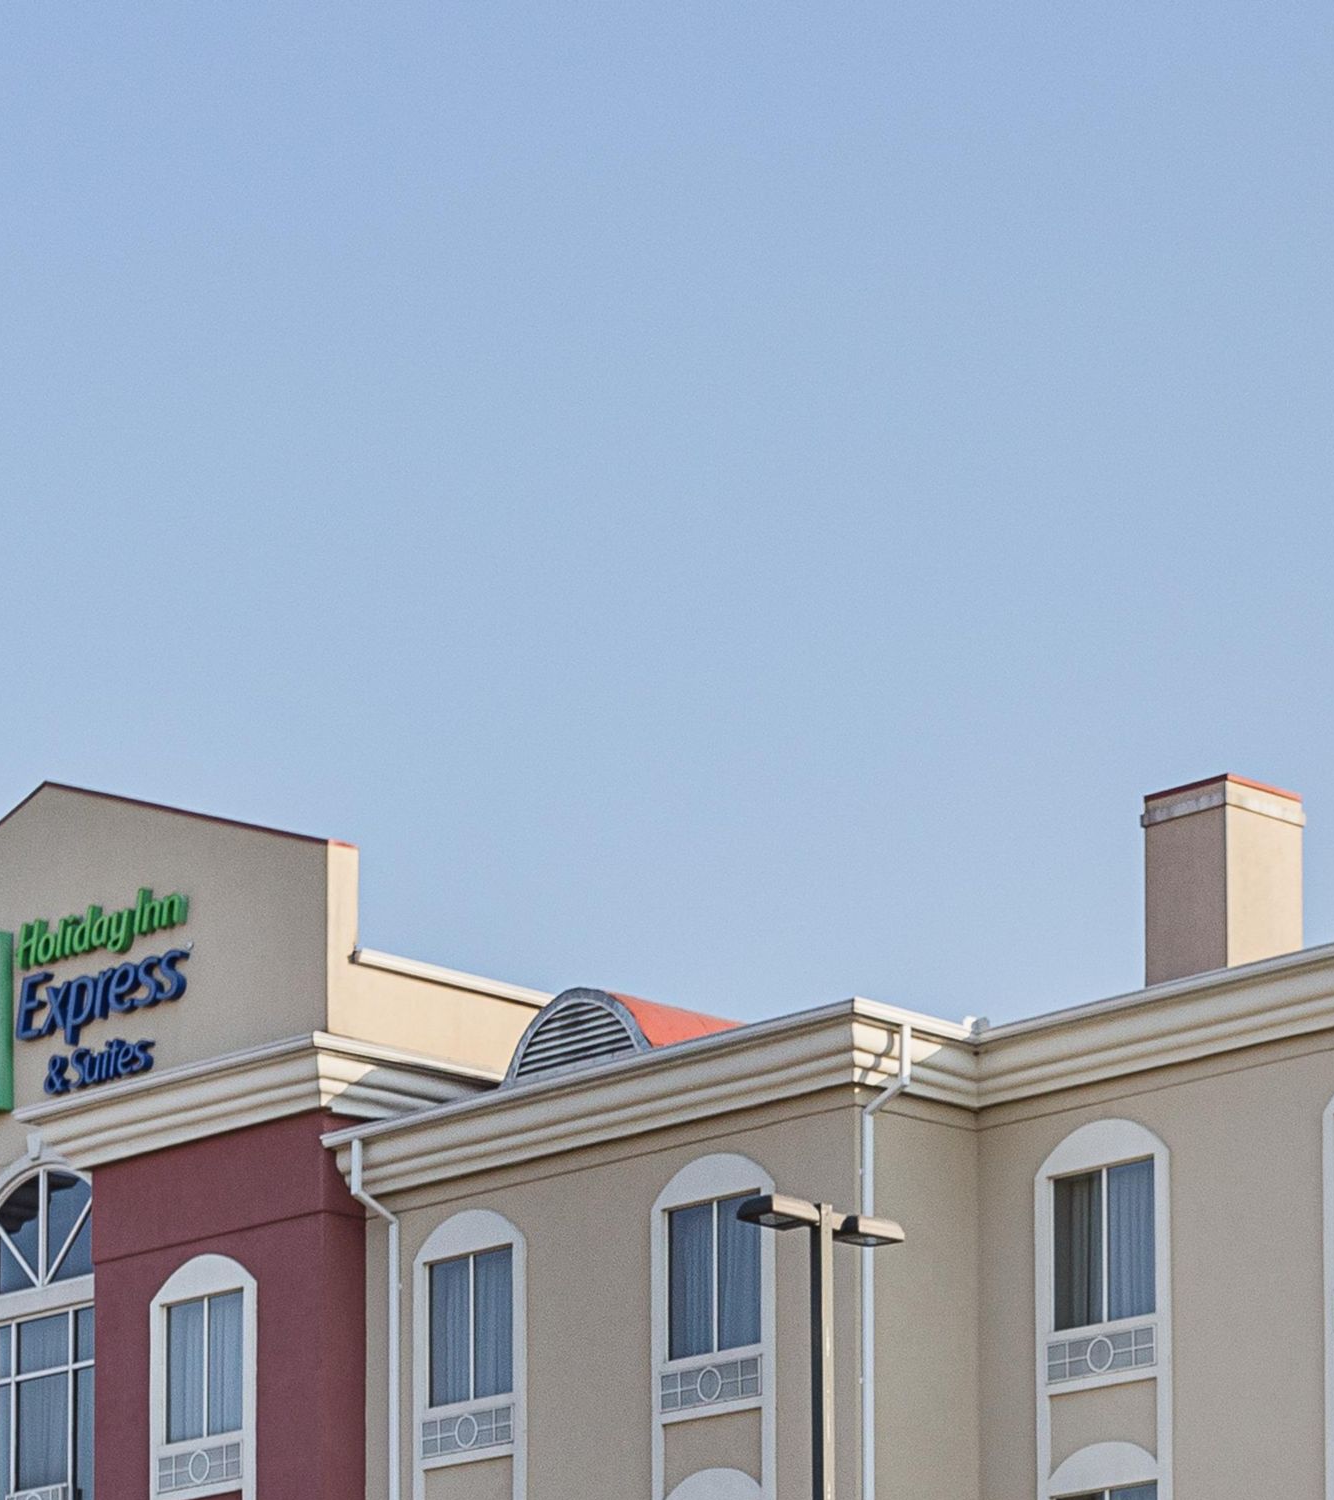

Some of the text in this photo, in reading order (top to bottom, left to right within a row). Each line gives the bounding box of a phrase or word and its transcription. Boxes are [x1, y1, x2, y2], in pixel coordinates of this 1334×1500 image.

[17, 888, 189, 970] Holiday Inn
[17, 950, 191, 1046] Express
[44, 1038, 156, 1095] & Suites
